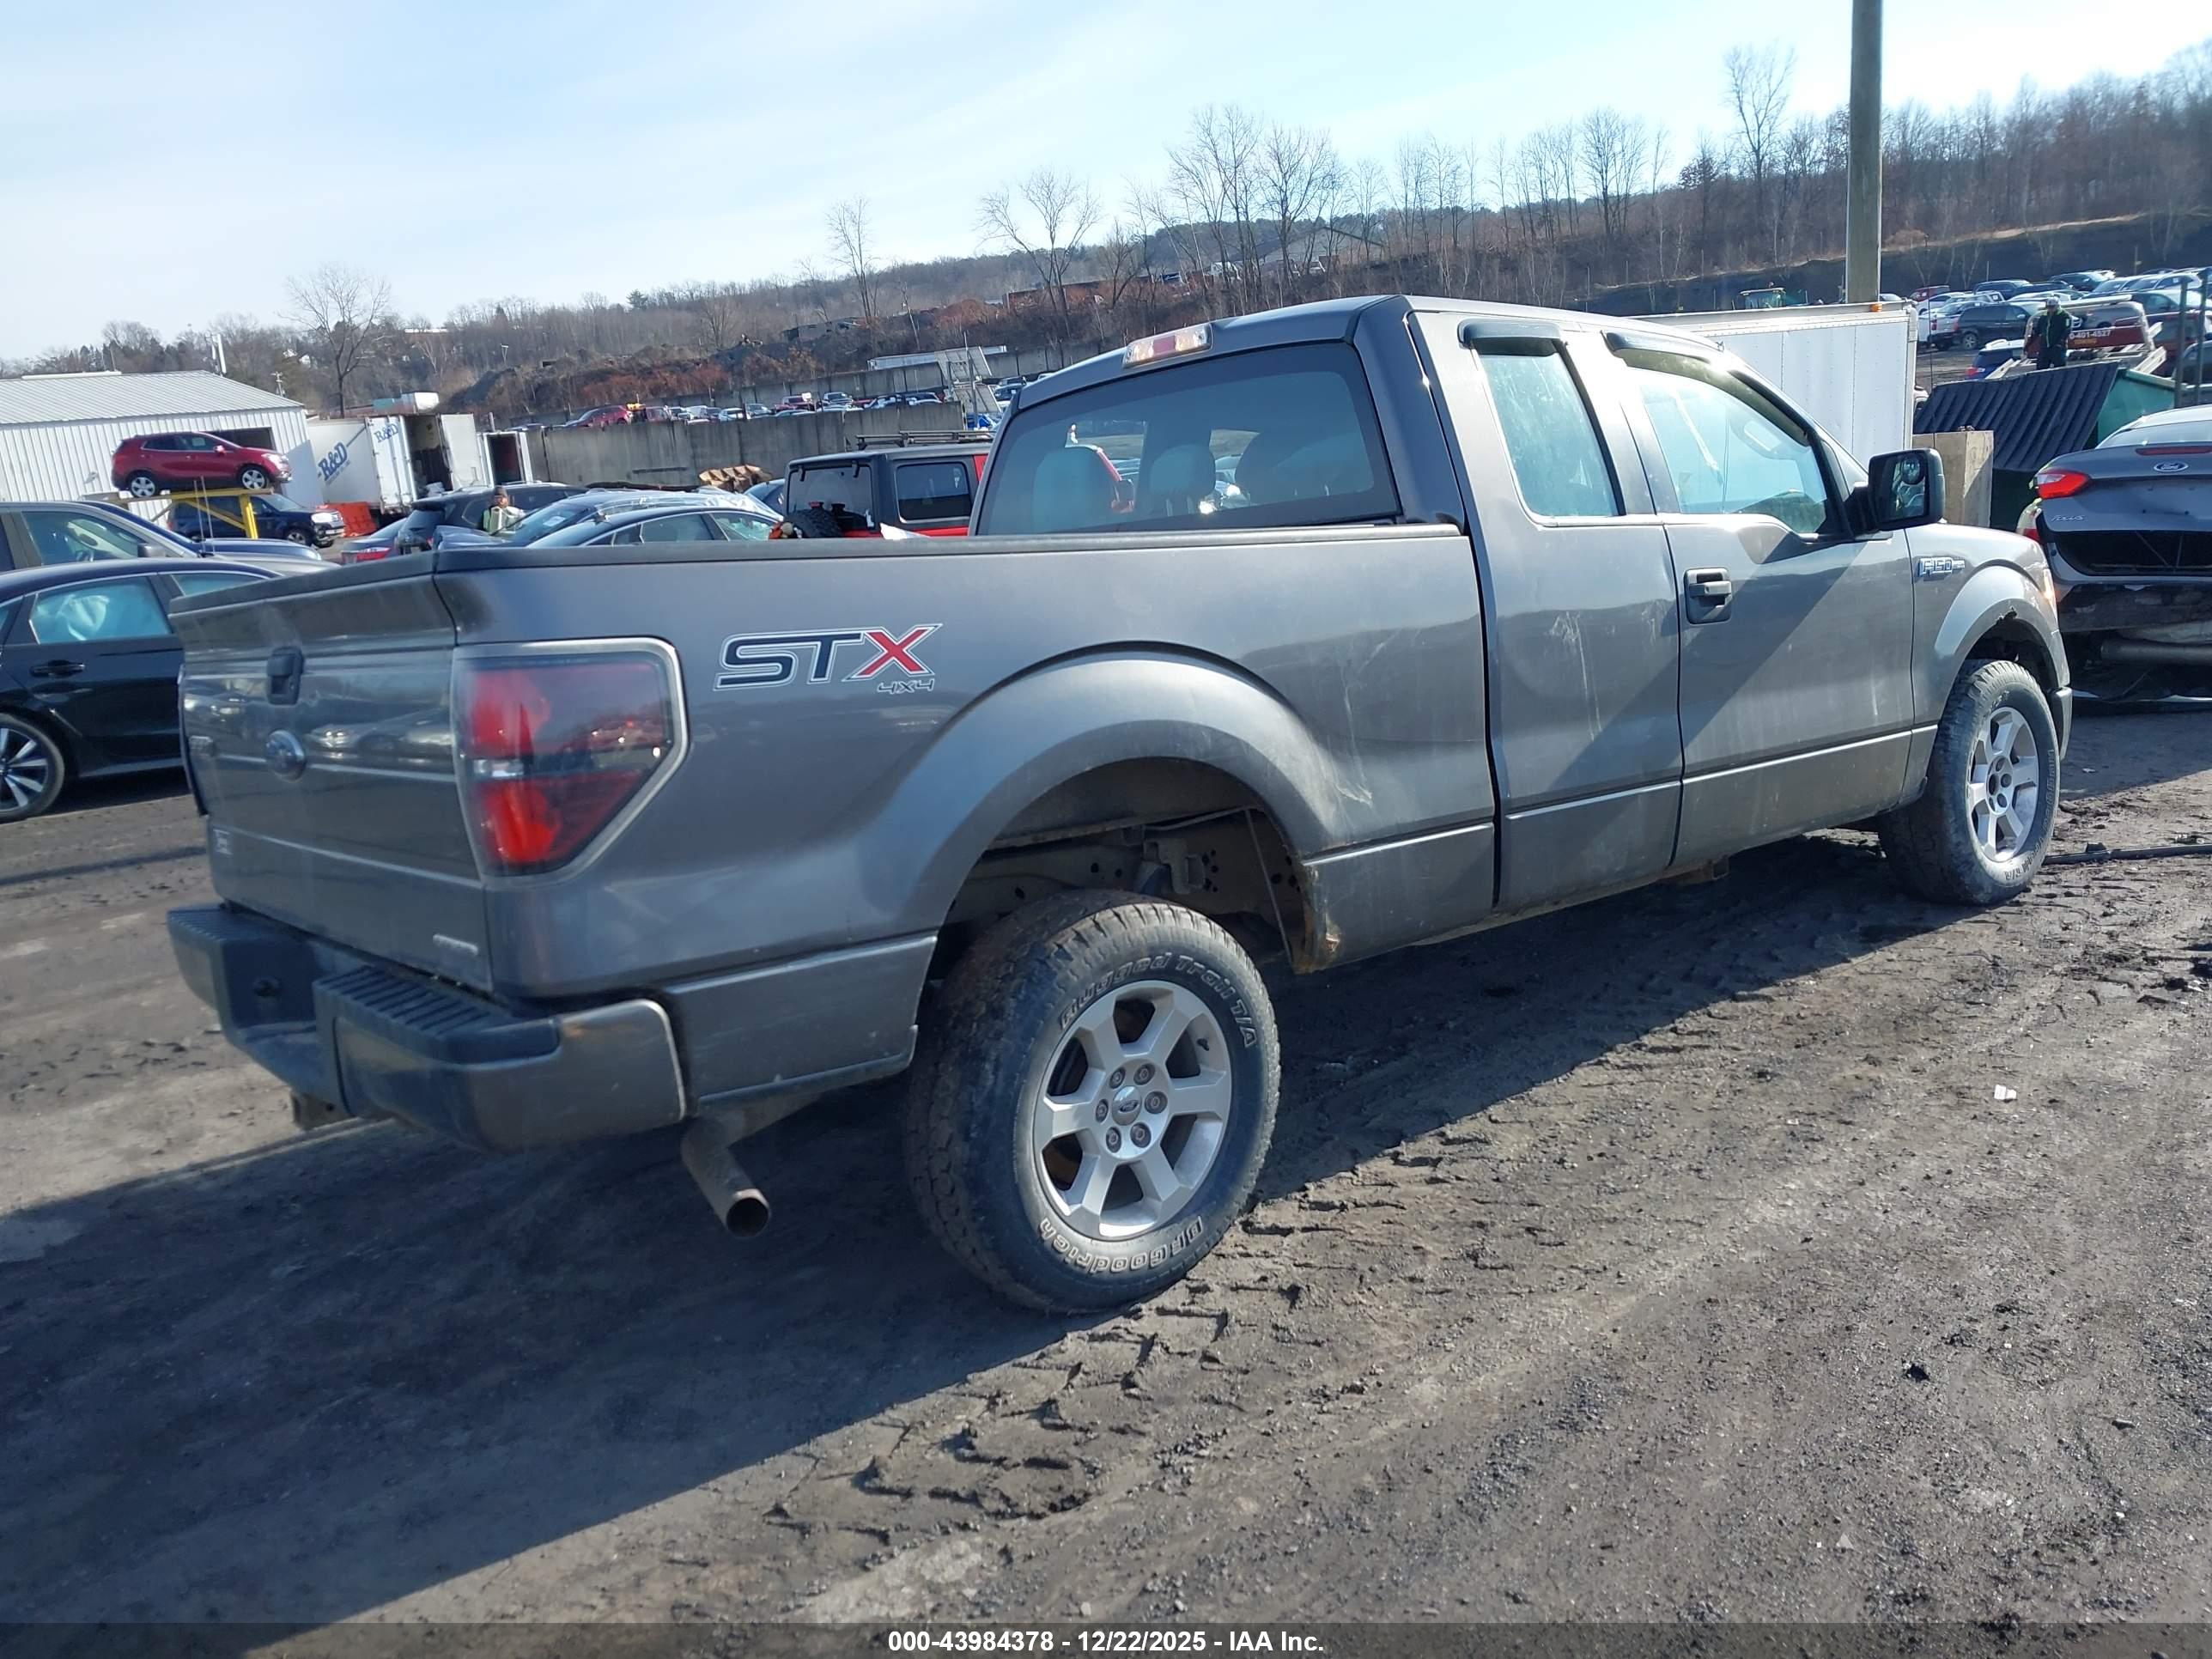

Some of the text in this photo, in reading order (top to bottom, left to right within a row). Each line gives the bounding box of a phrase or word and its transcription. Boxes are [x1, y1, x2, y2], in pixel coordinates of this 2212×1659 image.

[318, 442, 347, 481] R&D
[374, 423, 398, 443] R&D
[713, 623, 943, 690] STX
[1060, 951, 1257, 1048] Rugged Trail T/A
[1039, 1216, 1202, 1274] BFGoodrich
